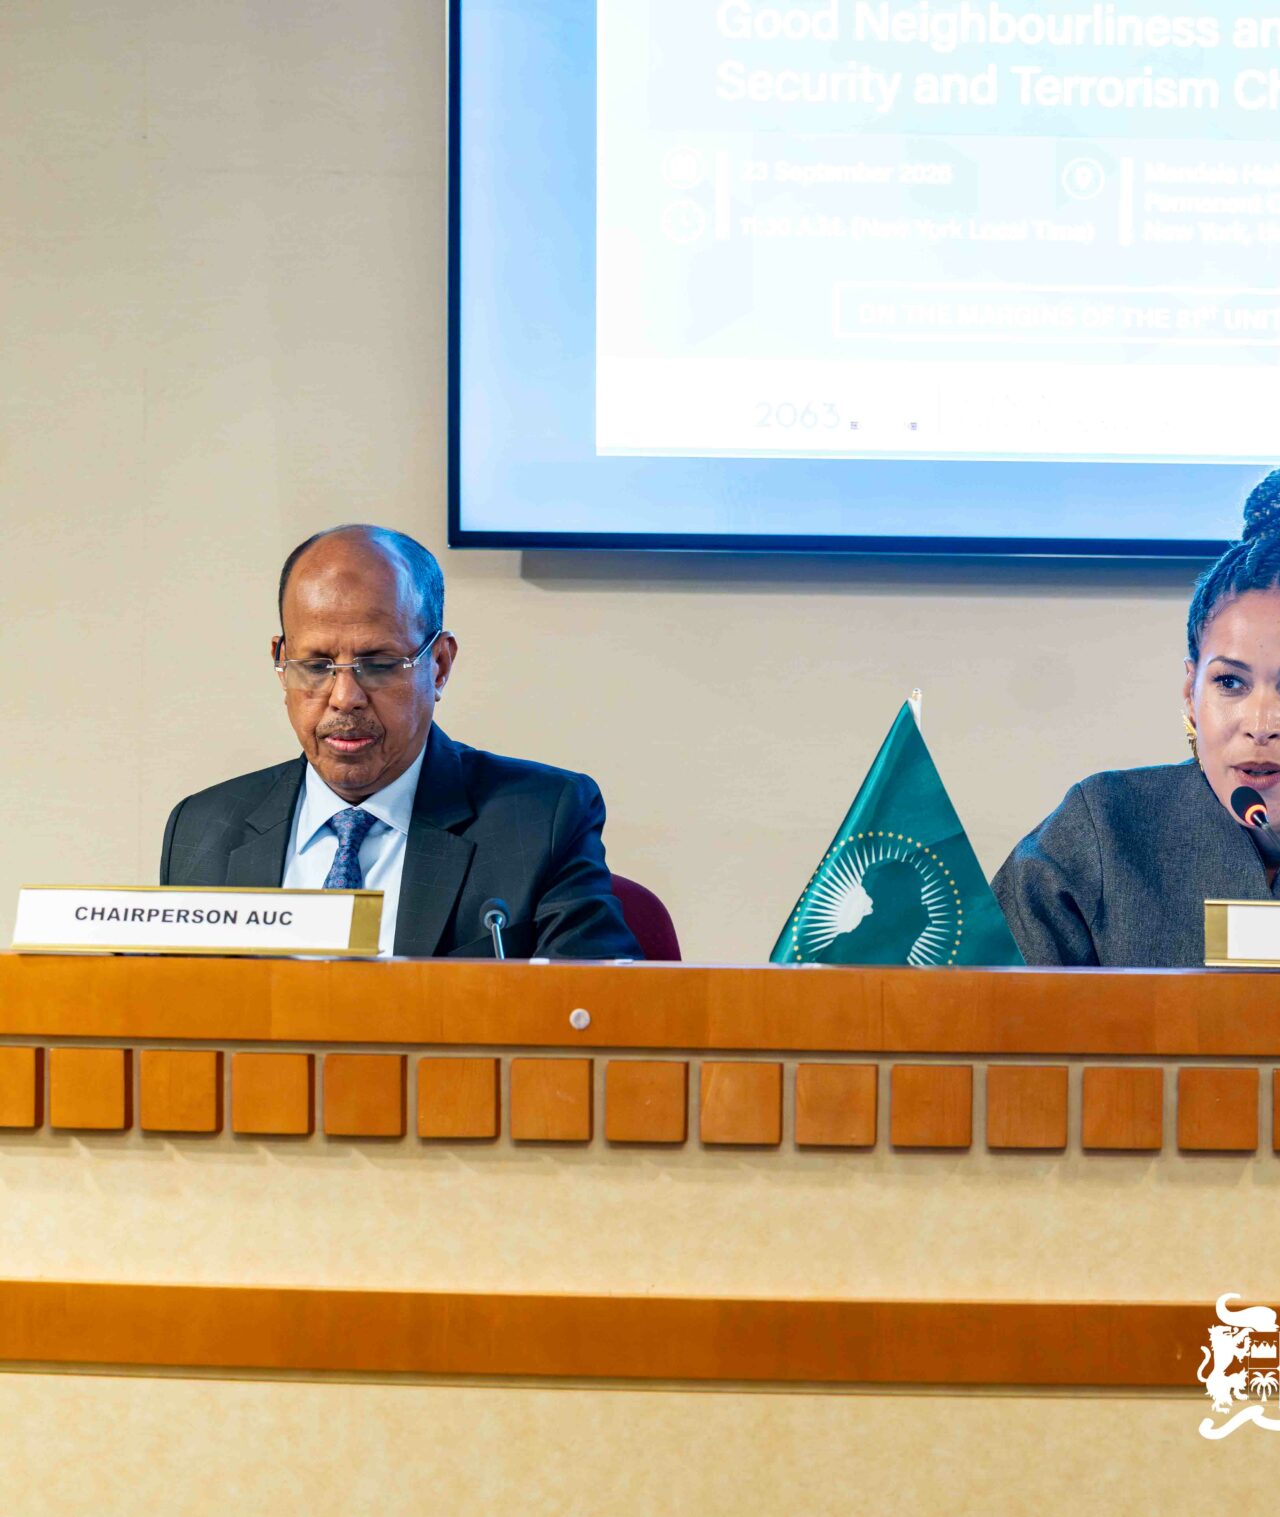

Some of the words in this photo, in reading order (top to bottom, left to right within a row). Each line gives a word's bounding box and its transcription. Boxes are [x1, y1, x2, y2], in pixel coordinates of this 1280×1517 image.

[716, 0, 838, 41] Good
[855, 0, 1220, 52] Neighbourliness
[716, 60, 901, 112] Security
[914, 64, 998, 105] and
[1009, 65, 1220, 110] Terrorism
[774, 160, 893, 187] September
[858, 303, 896, 325] ON
[902, 304, 950, 326] THE
[957, 305, 1075, 328] MARGINS
[1081, 305, 1115, 329] OF
[1122, 307, 1170, 329] THE
[753, 402, 841, 431] 2063
[75, 906, 238, 925] CHAIRPERSON
[245, 910, 293, 926] AUC
